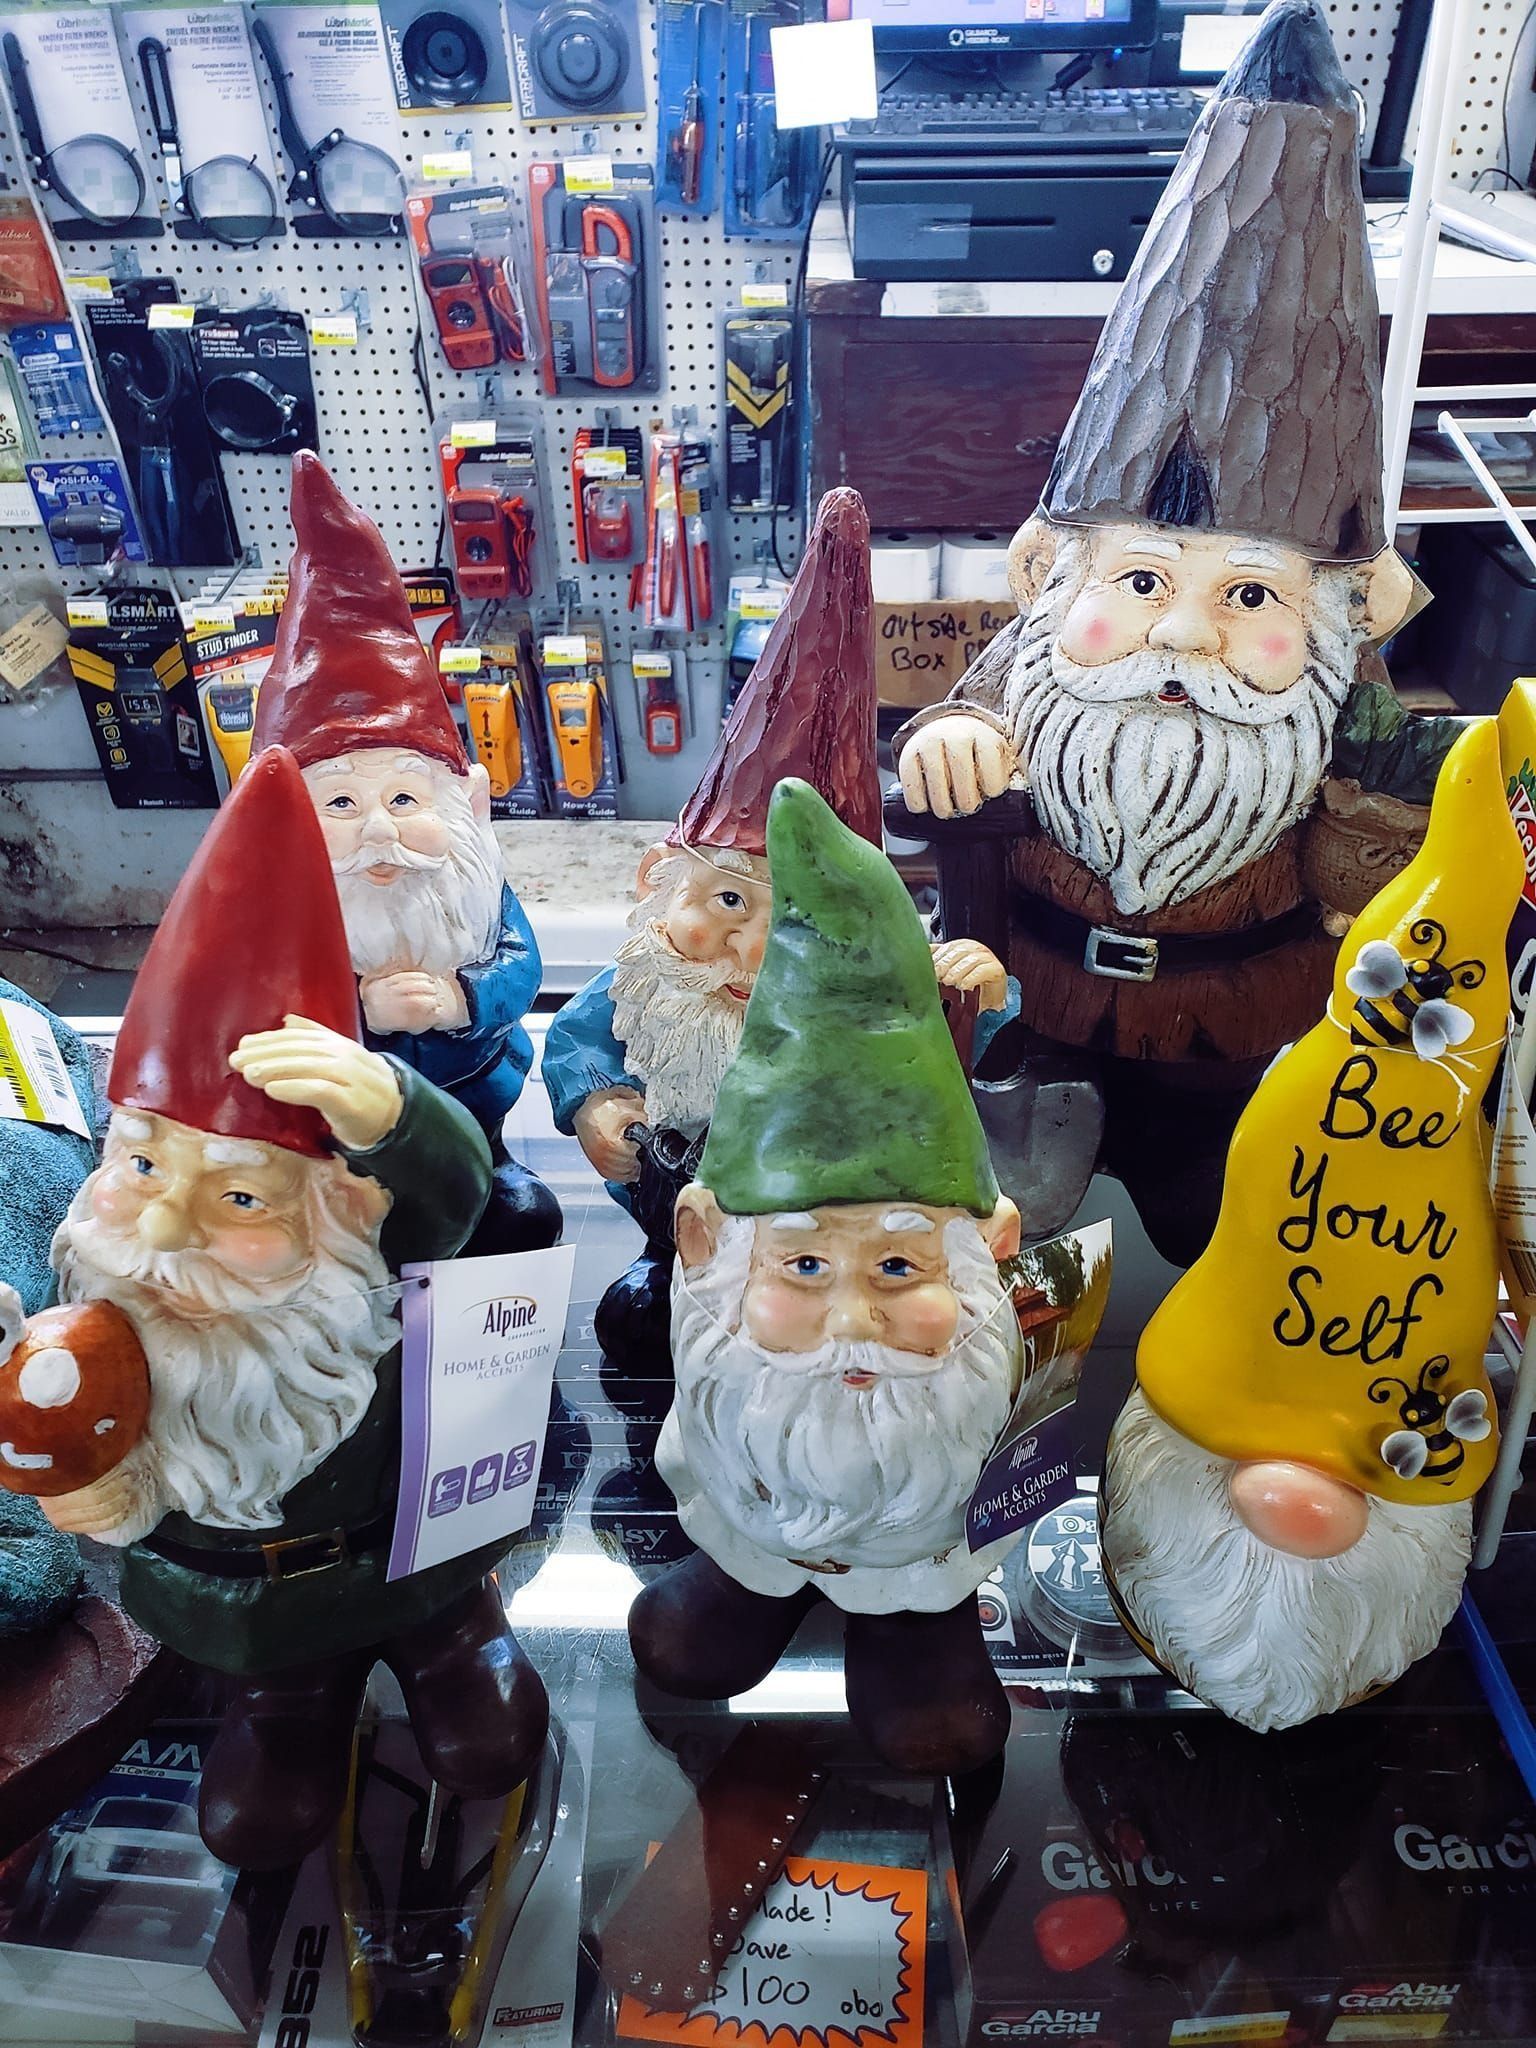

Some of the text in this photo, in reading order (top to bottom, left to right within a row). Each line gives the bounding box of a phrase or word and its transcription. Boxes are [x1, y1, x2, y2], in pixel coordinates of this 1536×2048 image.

[386, 24, 412, 109] EVERCRAFT
[513, 33, 536, 118] EVERCRAFT
[106, 598, 178, 618] LSMART
[197, 629, 259, 658] STUD FINDER
[891, 646, 945, 671] Box
[509, 808, 537, 816] Guide
[562, 801, 598, 809] How-to
[588, 808, 617, 816] Guide
[1319, 1054, 1462, 1149] Bee
[1277, 1145, 1458, 1260] Your
[482, 1299, 537, 1338] Alpine
[1273, 1265, 1444, 1365] Self
[444, 1343, 551, 1376] HOME & GARDEN
[476, 1363, 525, 1381] ACCENTS
[561, 1451, 653, 1474] Daisy
[1008, 1440, 1038, 1471] Alpine
[973, 1461, 1069, 1522] HOME & GARDEN
[1003, 1490, 1047, 1521] ACCENTS
[120, 1738, 201, 1769] AM
[127, 1766, 166, 1777] Camera
[1149, 1900, 1201, 1912] LIFE
[1338, 1993, 1455, 2009] Garcia
[1384, 1983, 1462, 1996] Abu
[494, 2004, 563, 2024] FEATURING
[840, 1989, 884, 2017] obo
[980, 2021, 1098, 2036] Garcia
[1026, 2008, 1101, 2024] Abu
